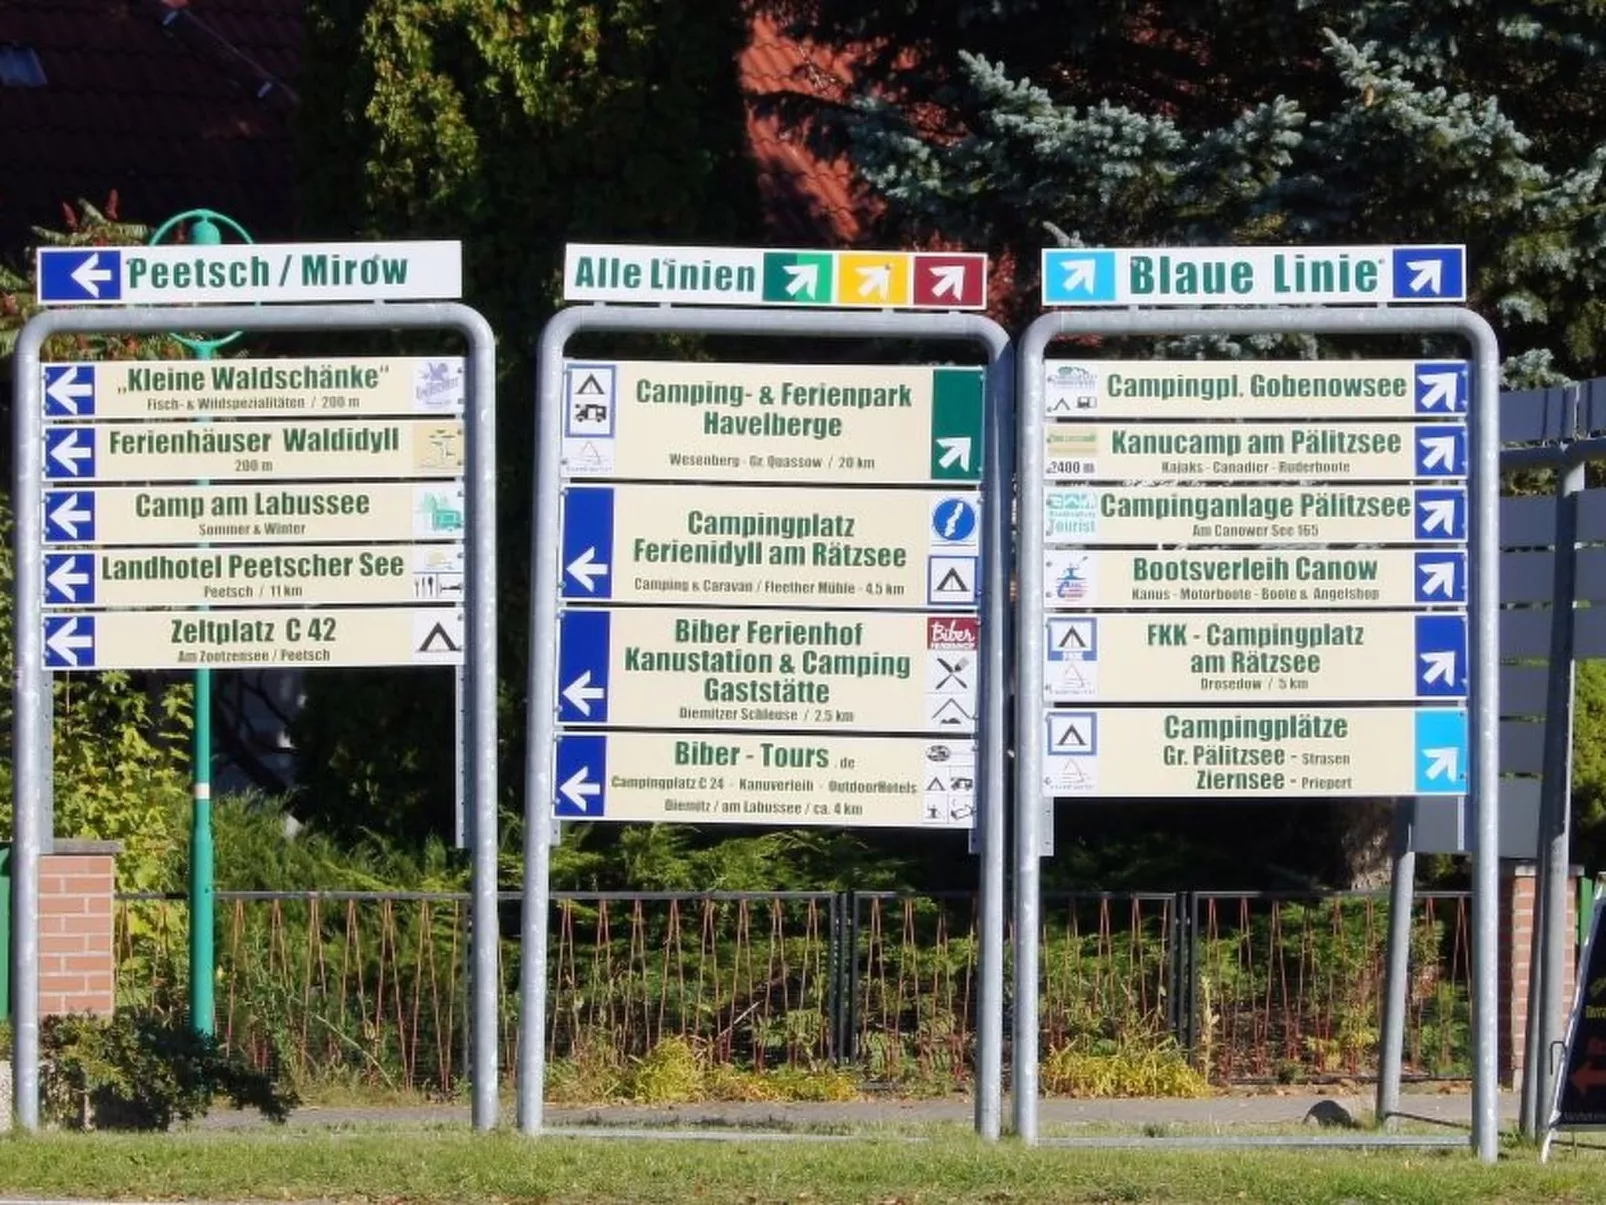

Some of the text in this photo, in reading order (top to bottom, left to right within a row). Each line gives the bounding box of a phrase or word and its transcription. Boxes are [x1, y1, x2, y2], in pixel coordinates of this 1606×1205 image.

[127, 255, 270, 289] Peetsch
[301, 254, 408, 287] Mirow
[574, 256, 756, 293] Alle Linien
[1129, 253, 1381, 295] Blaue Linie
[636, 378, 912, 410] Camping- & Ferienpark
[1107, 373, 1244, 401] Campingpl.
[1250, 373, 1407, 398] Gobenowsee
[147, 397, 184, 411] Fisch-
[185, 398, 195, 410] &
[196, 396, 305, 411] Wildspezialitäten
[321, 395, 346, 409] 200
[703, 411, 843, 441] Havelberge
[109, 427, 399, 455] Ferienhäuser Waldidyll
[1112, 429, 1402, 457] Kanucamp am Pälitzsee
[235, 458, 259, 473] 200
[669, 453, 740, 468] Wesenberg
[767, 454, 823, 469] Quassow
[838, 456, 855, 469] 20
[856, 456, 875, 469] km
[1161, 460, 1204, 475] Kajaks
[1212, 460, 1269, 474] Canadier
[1278, 460, 1351, 474] Ruderboote
[135, 491, 370, 520] Camp am Labussee
[1100, 493, 1294, 521] Campinganlage
[1300, 492, 1411, 518] Pälitzsee
[198, 522, 306, 537] Sommer & Winter
[688, 510, 855, 540] Campingplatz
[1214, 523, 1269, 537] Canower
[1270, 523, 1295, 538] See
[1297, 523, 1319, 537] 165
[102, 551, 404, 581] Landhotel Peetscher See
[633, 538, 907, 568] Ferienidyll am Rätzsee
[1133, 555, 1378, 582] Bootsverleih Canow
[203, 585, 254, 599] Peetsch
[634, 577, 690, 593] Camping
[691, 580, 701, 592] &
[702, 579, 753, 593] Caravan
[817, 581, 856, 595] Mühle
[885, 583, 905, 596] km
[1131, 587, 1171, 601] Kanus
[1180, 587, 1252, 601] Motorboote
[1261, 587, 1297, 601] Boote
[1299, 588, 1309, 601] &
[1313, 587, 1380, 602] Angelshop
[170, 616, 337, 646] Zeltplatz C 42
[675, 618, 863, 646] Biber Ferienhof
[930, 622, 975, 642] Biber
[1147, 623, 1187, 646] FKK
[1206, 623, 1364, 651] Campingplatz
[280, 648, 331, 662] Peetsch
[624, 646, 911, 680] Kanustation & Camping
[1190, 649, 1321, 674] am Rätzsee
[704, 677, 830, 704] Gaststätte
[1200, 677, 1262, 691] Drosedow
[1278, 677, 1288, 690] 5
[1289, 677, 1309, 690] km
[679, 706, 738, 721] Diemitzer
[740, 707, 798, 722] Schleuse
[835, 709, 855, 723] km
[1164, 713, 1349, 743] Campingplätze
[674, 740, 741, 766] Biber
[759, 742, 829, 769] Tours
[1163, 744, 1188, 766] Gr.
[1193, 744, 1286, 766] Pälitzsee
[1301, 752, 1351, 766] Strasen
[610, 775, 697, 791] Campingplatz
[698, 776, 708, 790] C
[709, 776, 725, 790] 24
[739, 777, 814, 792] Kanuverleih
[1196, 769, 1285, 790] Ziernsee
[1301, 776, 1353, 791] Priepert
[721, 802, 741, 813] am
[743, 800, 802, 816] Labussee
[833, 802, 842, 815] 4
[843, 802, 863, 816] km
